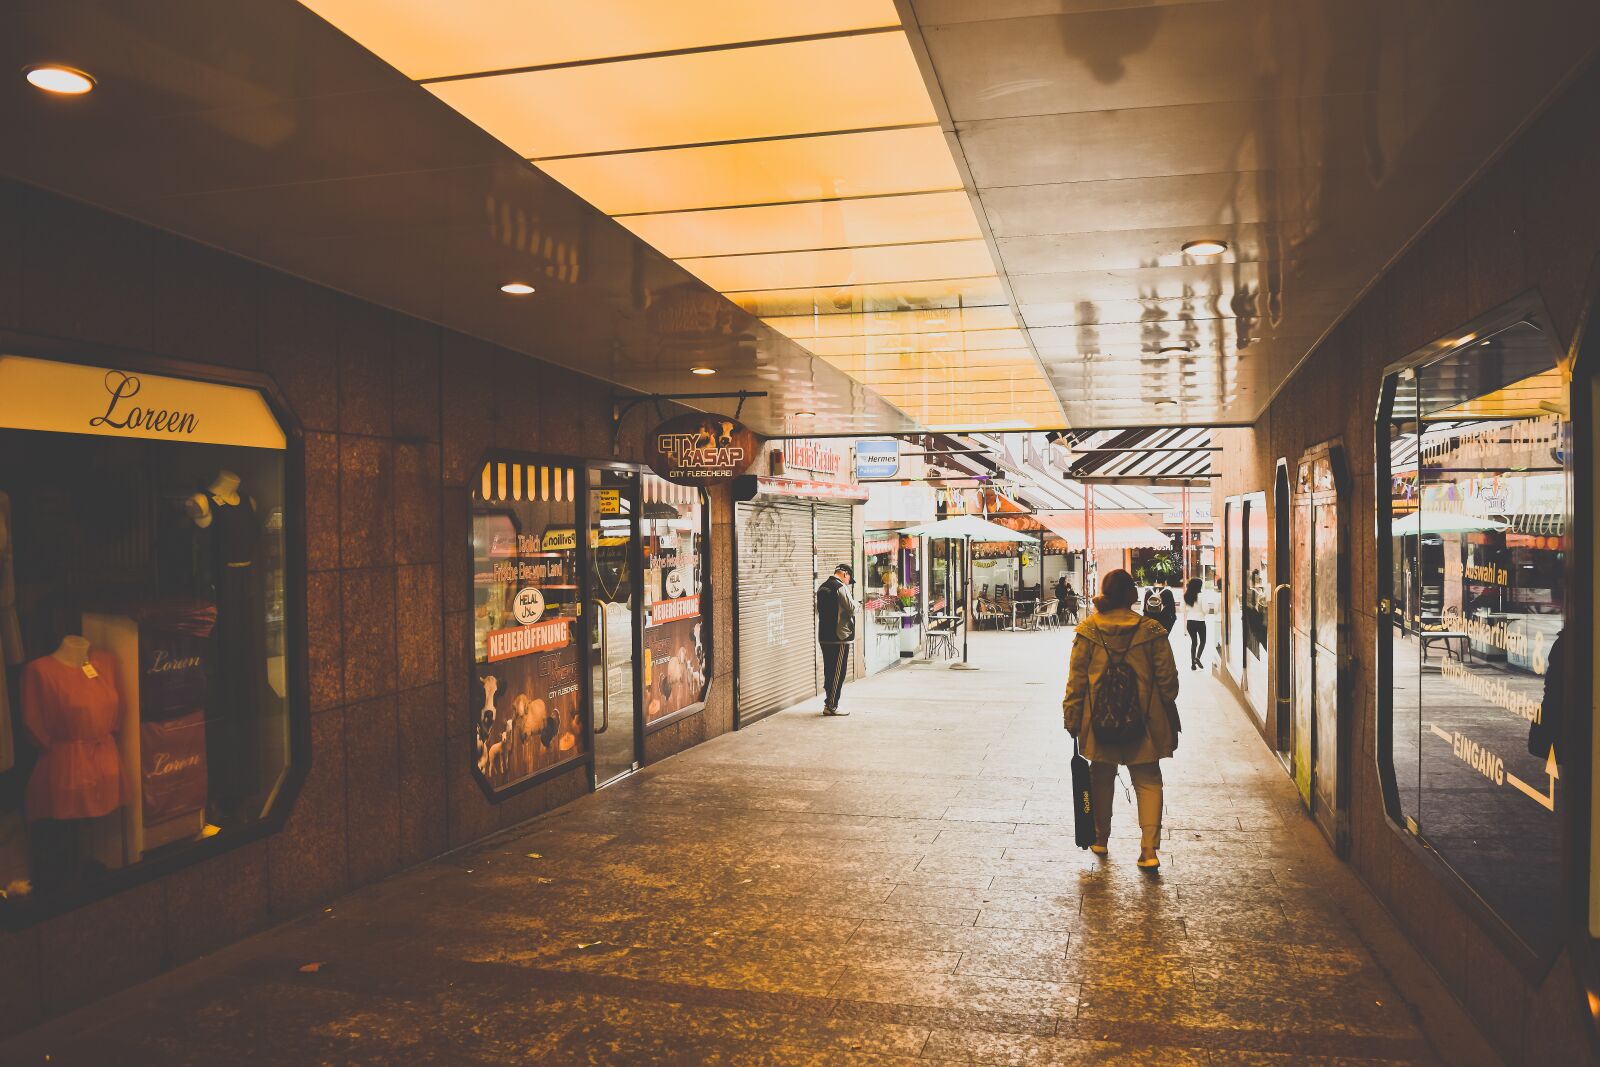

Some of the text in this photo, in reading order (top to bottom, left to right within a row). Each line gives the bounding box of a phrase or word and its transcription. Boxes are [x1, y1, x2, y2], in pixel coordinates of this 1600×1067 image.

[89, 369, 199, 433] Loreen
[658, 434, 701, 454] CITY
[679, 448, 744, 467] KASAP
[868, 455, 896, 463] Hermes
[1465, 562, 1496, 584] Auswahl
[1497, 568, 1508, 586] an
[519, 594, 538, 605] HELAL
[653, 599, 699, 621] NEUERÖFFNUNG
[490, 622, 567, 657] NEUERÖFFNUNG
[1532, 631, 1545, 675] &
[1441, 655, 1542, 725] Glückwunschkarten
[1453, 731, 1504, 786] EINGANG
